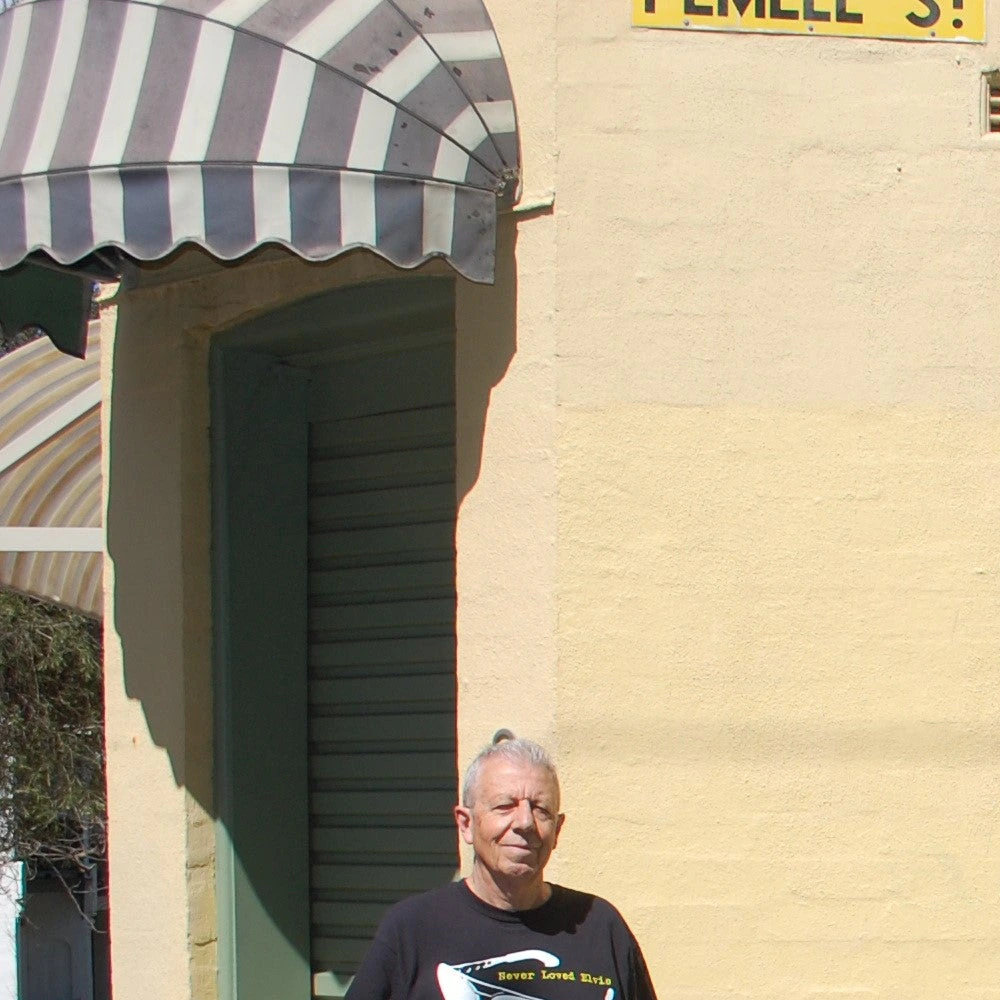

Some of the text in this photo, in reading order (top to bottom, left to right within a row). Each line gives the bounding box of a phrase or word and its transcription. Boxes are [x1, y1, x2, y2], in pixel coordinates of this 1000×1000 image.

[498, 970, 612, 986] Never Loved Elvis
